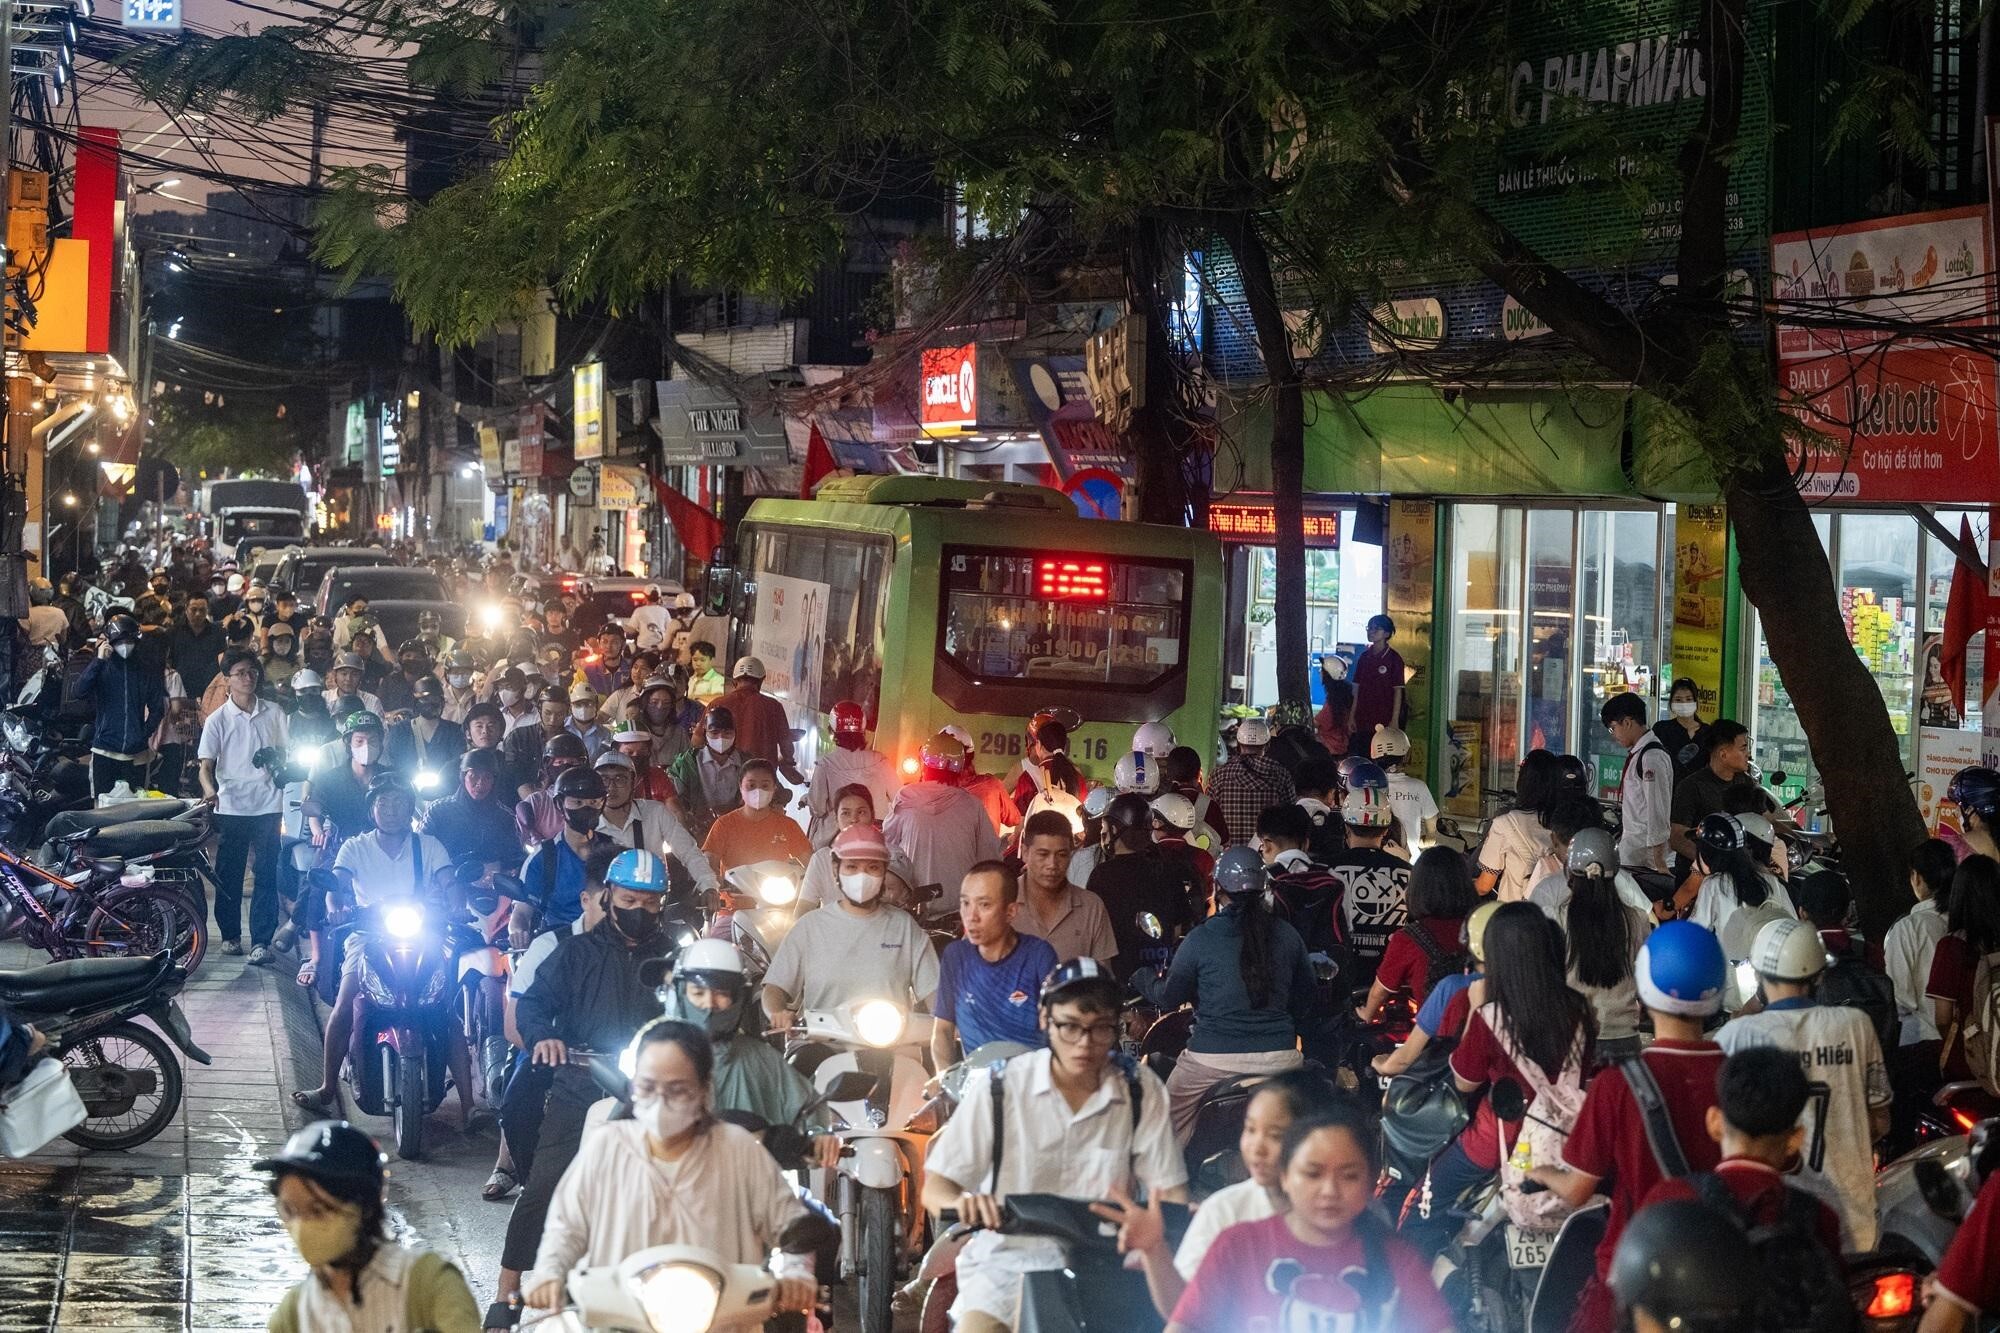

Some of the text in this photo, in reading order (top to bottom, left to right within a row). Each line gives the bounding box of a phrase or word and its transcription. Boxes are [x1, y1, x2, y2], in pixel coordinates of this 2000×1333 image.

[925, 373, 958, 406] CIRCLE
[688, 409, 741, 432] THE NIGHT
[1877, 448, 1893, 475] hội
[980, 732, 1021, 756] 29B
[1603, 764, 1618, 781] BỐC
[1925, 766, 1941, 775] CHO
[1395, 791, 1420, 802] Privé
[7, 875, 46, 918] DRAGON
[1816, 1041, 1853, 1066] Hiếu
[1808, 1080, 1831, 1173] 7
[1514, 1245, 1546, 1265] 265
